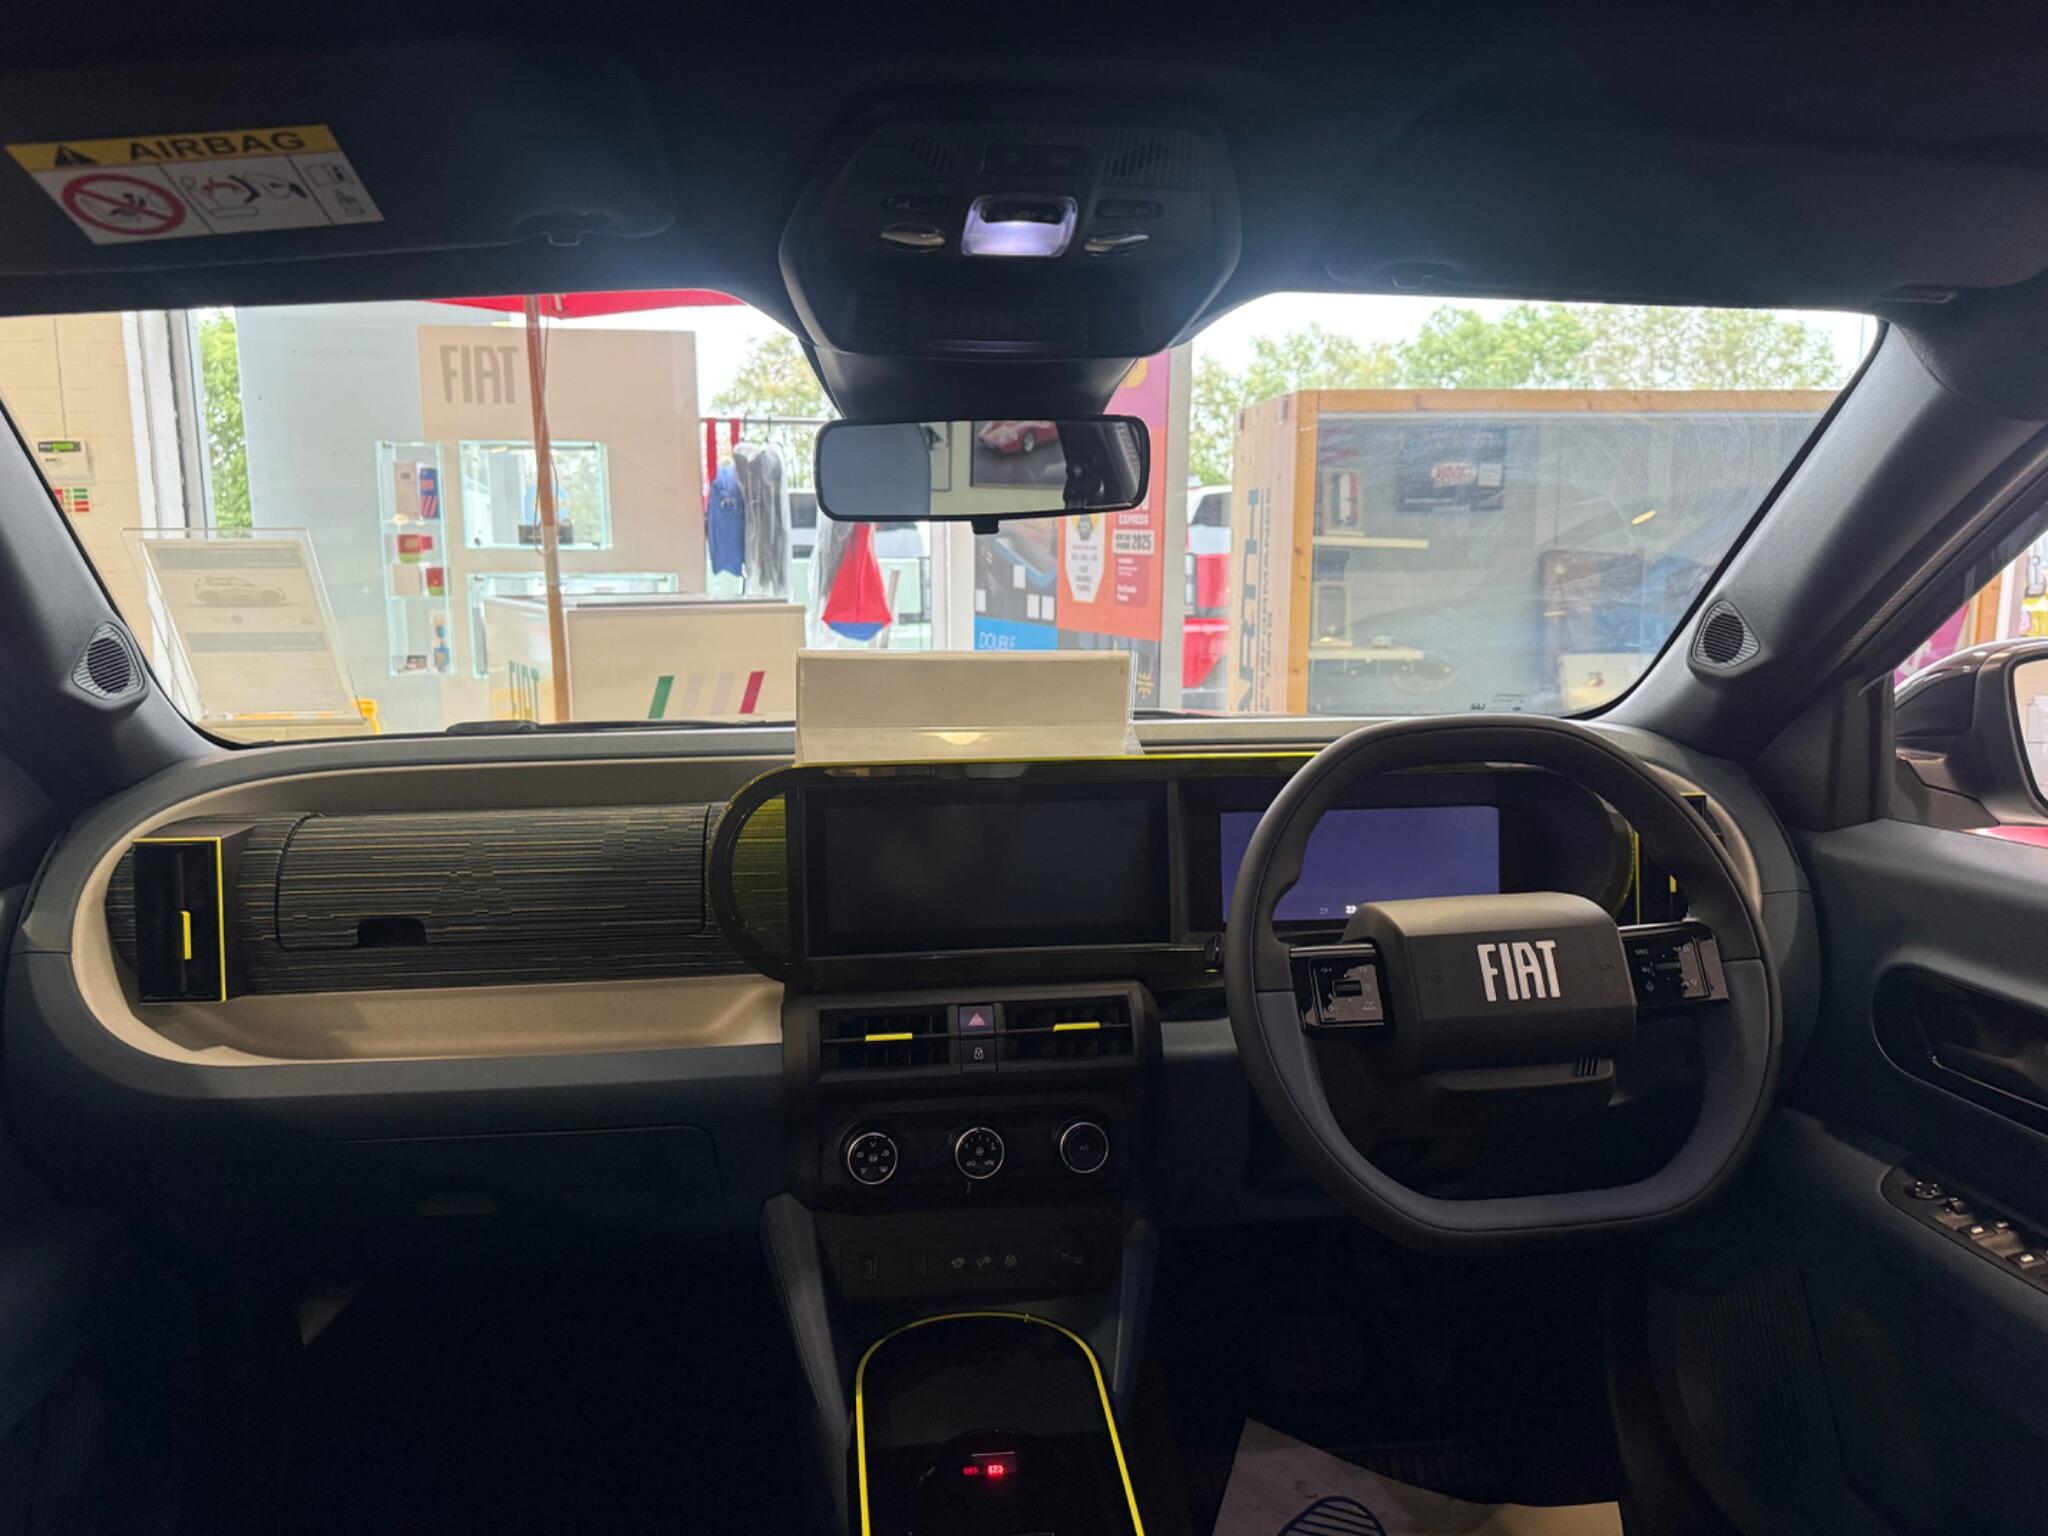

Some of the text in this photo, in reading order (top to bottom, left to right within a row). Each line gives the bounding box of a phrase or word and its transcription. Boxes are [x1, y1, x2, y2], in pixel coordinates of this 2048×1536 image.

[129, 131, 306, 161] AIRBAG
[439, 345, 518, 404] FIAT
[1476, 939, 1562, 1002] FIAT
